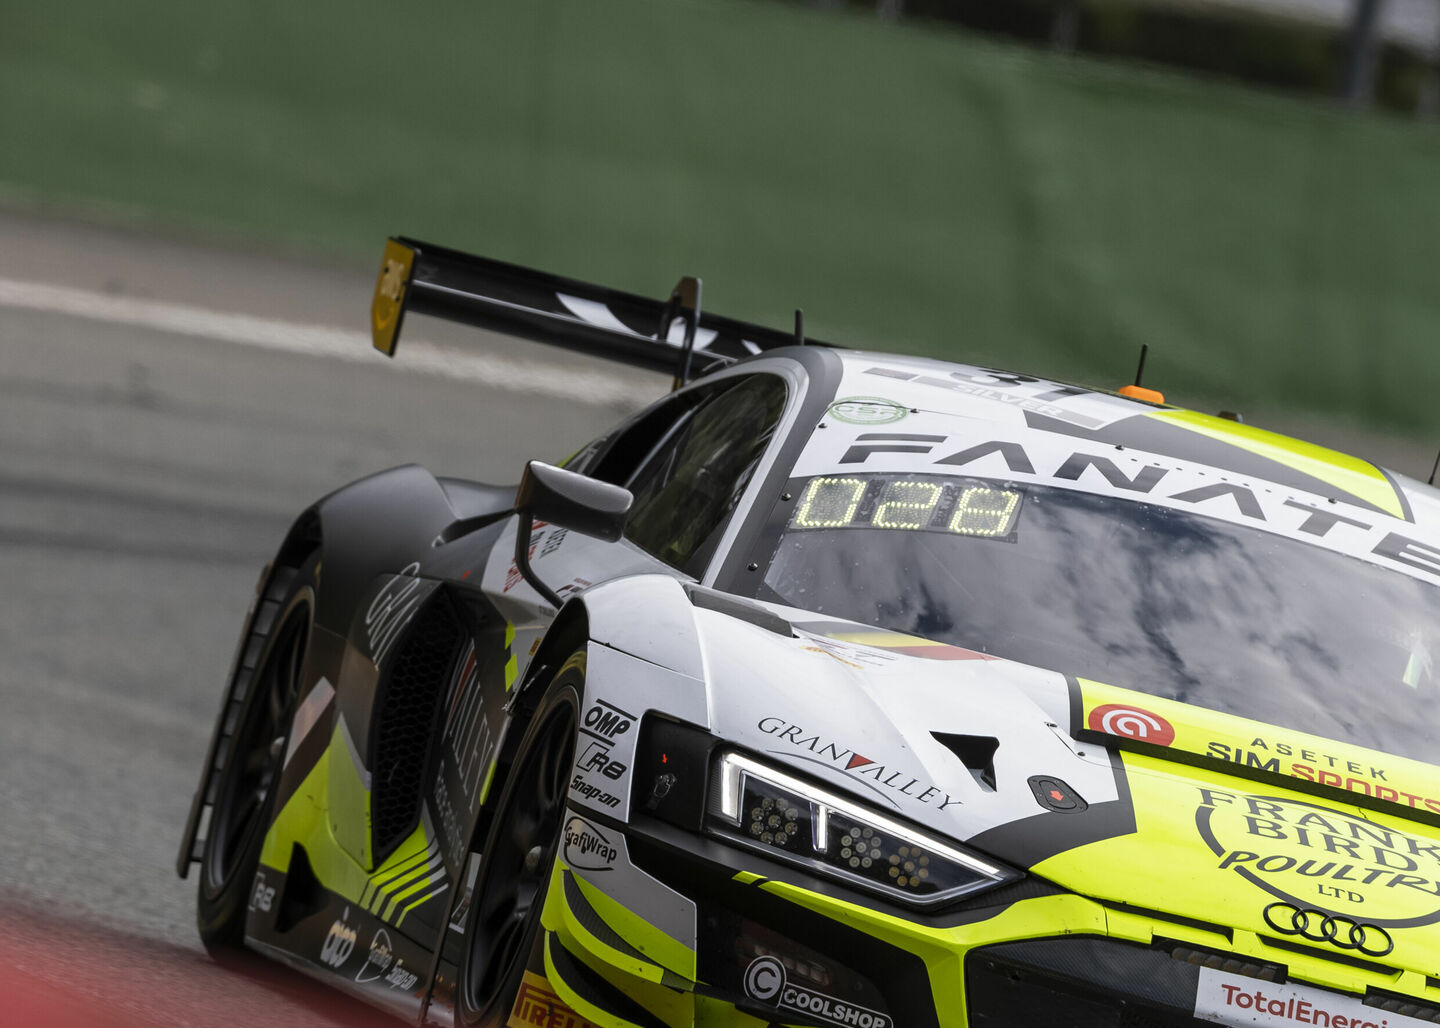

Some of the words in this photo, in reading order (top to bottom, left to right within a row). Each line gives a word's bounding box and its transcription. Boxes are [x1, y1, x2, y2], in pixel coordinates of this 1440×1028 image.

[951, 384, 1063, 416] SILVER
[796, 477, 1019, 536] 028
[584, 706, 631, 739] OMP
[584, 748, 628, 780] R8
[1206, 741, 1280, 773] SIM
[1251, 737, 1388, 782] ASETEK
[570, 774, 621, 809] Snap-on
[1244, 814, 1419, 873] BIRD
[1317, 883, 1365, 904] LTD
